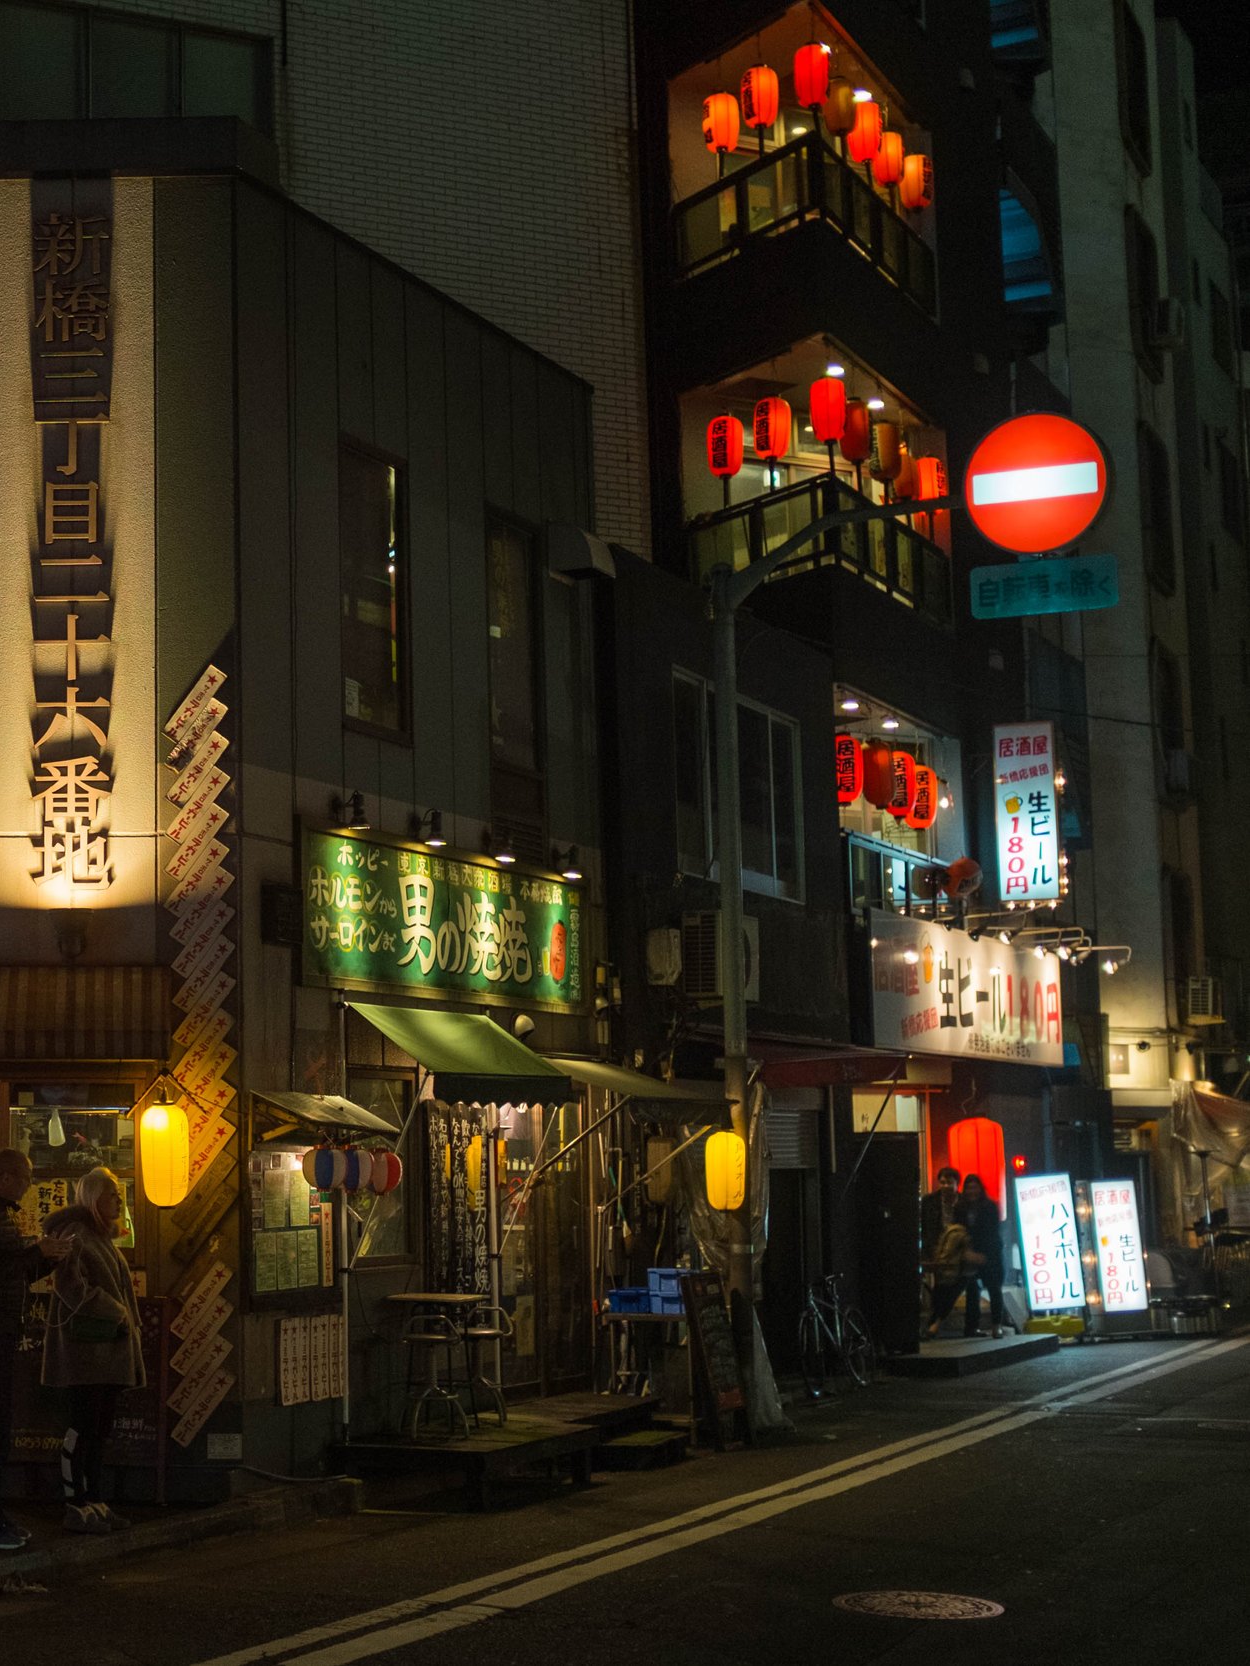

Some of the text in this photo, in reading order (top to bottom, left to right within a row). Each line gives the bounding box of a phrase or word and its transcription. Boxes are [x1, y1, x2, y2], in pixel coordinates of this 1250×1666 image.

[33, 211, 111, 890] 新橋三丁目二十六番地
[978, 568, 1112, 608] 自転車を除く
[998, 735, 1049, 758] 居酒屋
[999, 763, 1050, 786] 新橋応援団
[337, 840, 389, 871] ホッピー
[1005, 816, 1029, 895] 180円
[1027, 790, 1053, 885] 生ビール
[309, 867, 398, 919] ホルモンから
[310, 915, 398, 953] サーロインまで
[939, 951, 1061, 1045] 生ビール 180円
[37, 1186, 52, 1223] 新年
[1094, 1189, 1131, 1206] 居酒屋
[1032, 1235, 1054, 1305] 180円
[1051, 1203, 1080, 1299] ハイボール
[1119, 1234, 1140, 1292] 生ビール
[1107, 1252, 1124, 1305] 180円
